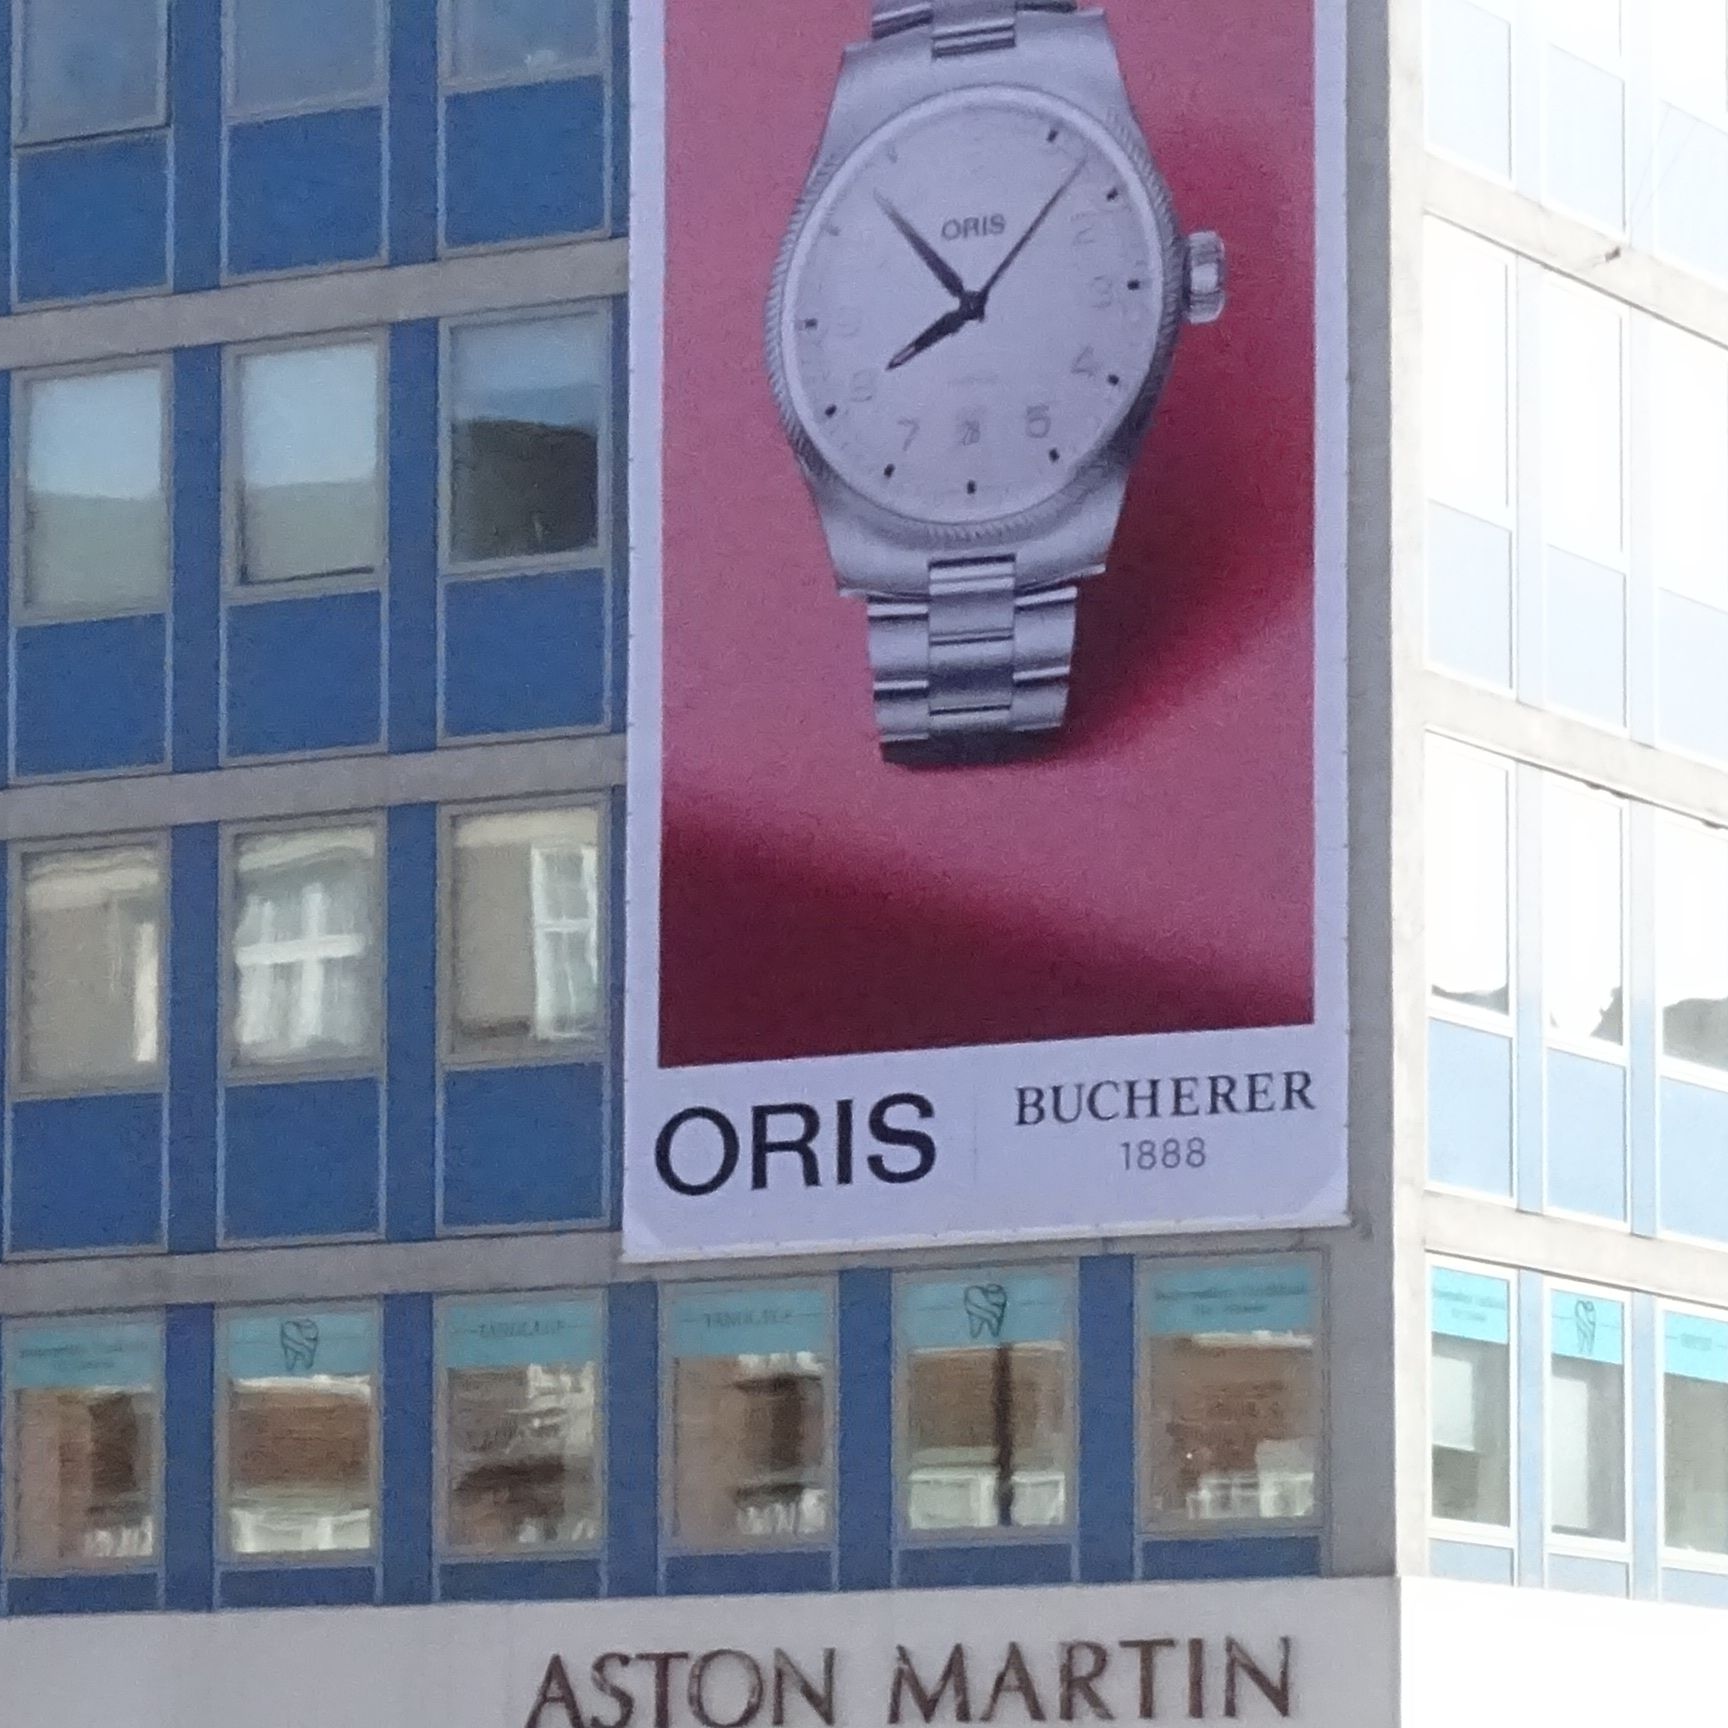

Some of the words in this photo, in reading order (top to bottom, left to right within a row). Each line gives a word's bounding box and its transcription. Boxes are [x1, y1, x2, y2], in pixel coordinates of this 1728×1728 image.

[940, 213, 1007, 242] ORIS
[1014, 1070, 1317, 1126] BUCHERER
[654, 1092, 937, 1197] ORIS
[1119, 1137, 1208, 1171] 1888
[886, 1635, 1294, 1726] MARTIN
